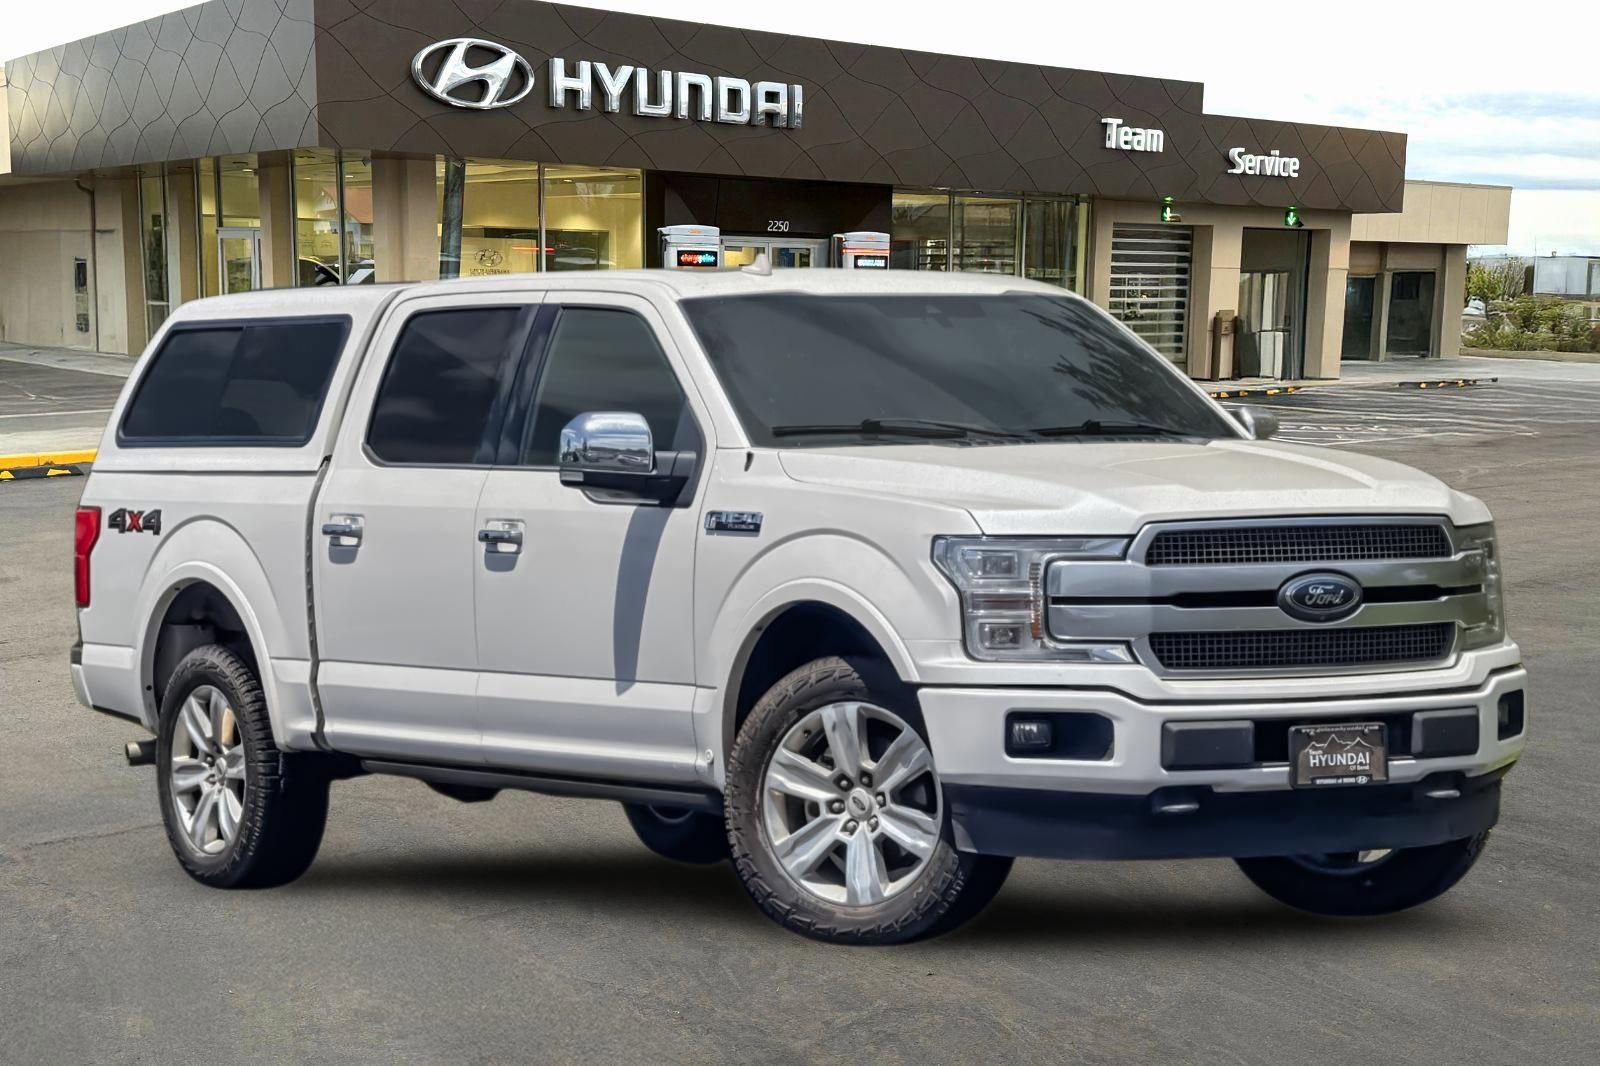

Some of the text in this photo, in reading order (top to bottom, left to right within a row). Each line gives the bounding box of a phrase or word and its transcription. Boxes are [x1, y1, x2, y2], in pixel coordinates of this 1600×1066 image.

[549, 57, 803, 129] HYUNDAI
[1101, 117, 1164, 152] Team
[1227, 147, 1300, 177] Service
[767, 220, 790, 232] 2250
[1304, 584, 1344, 605] Ford
[1310, 752, 1369, 767] HYUNDAI
